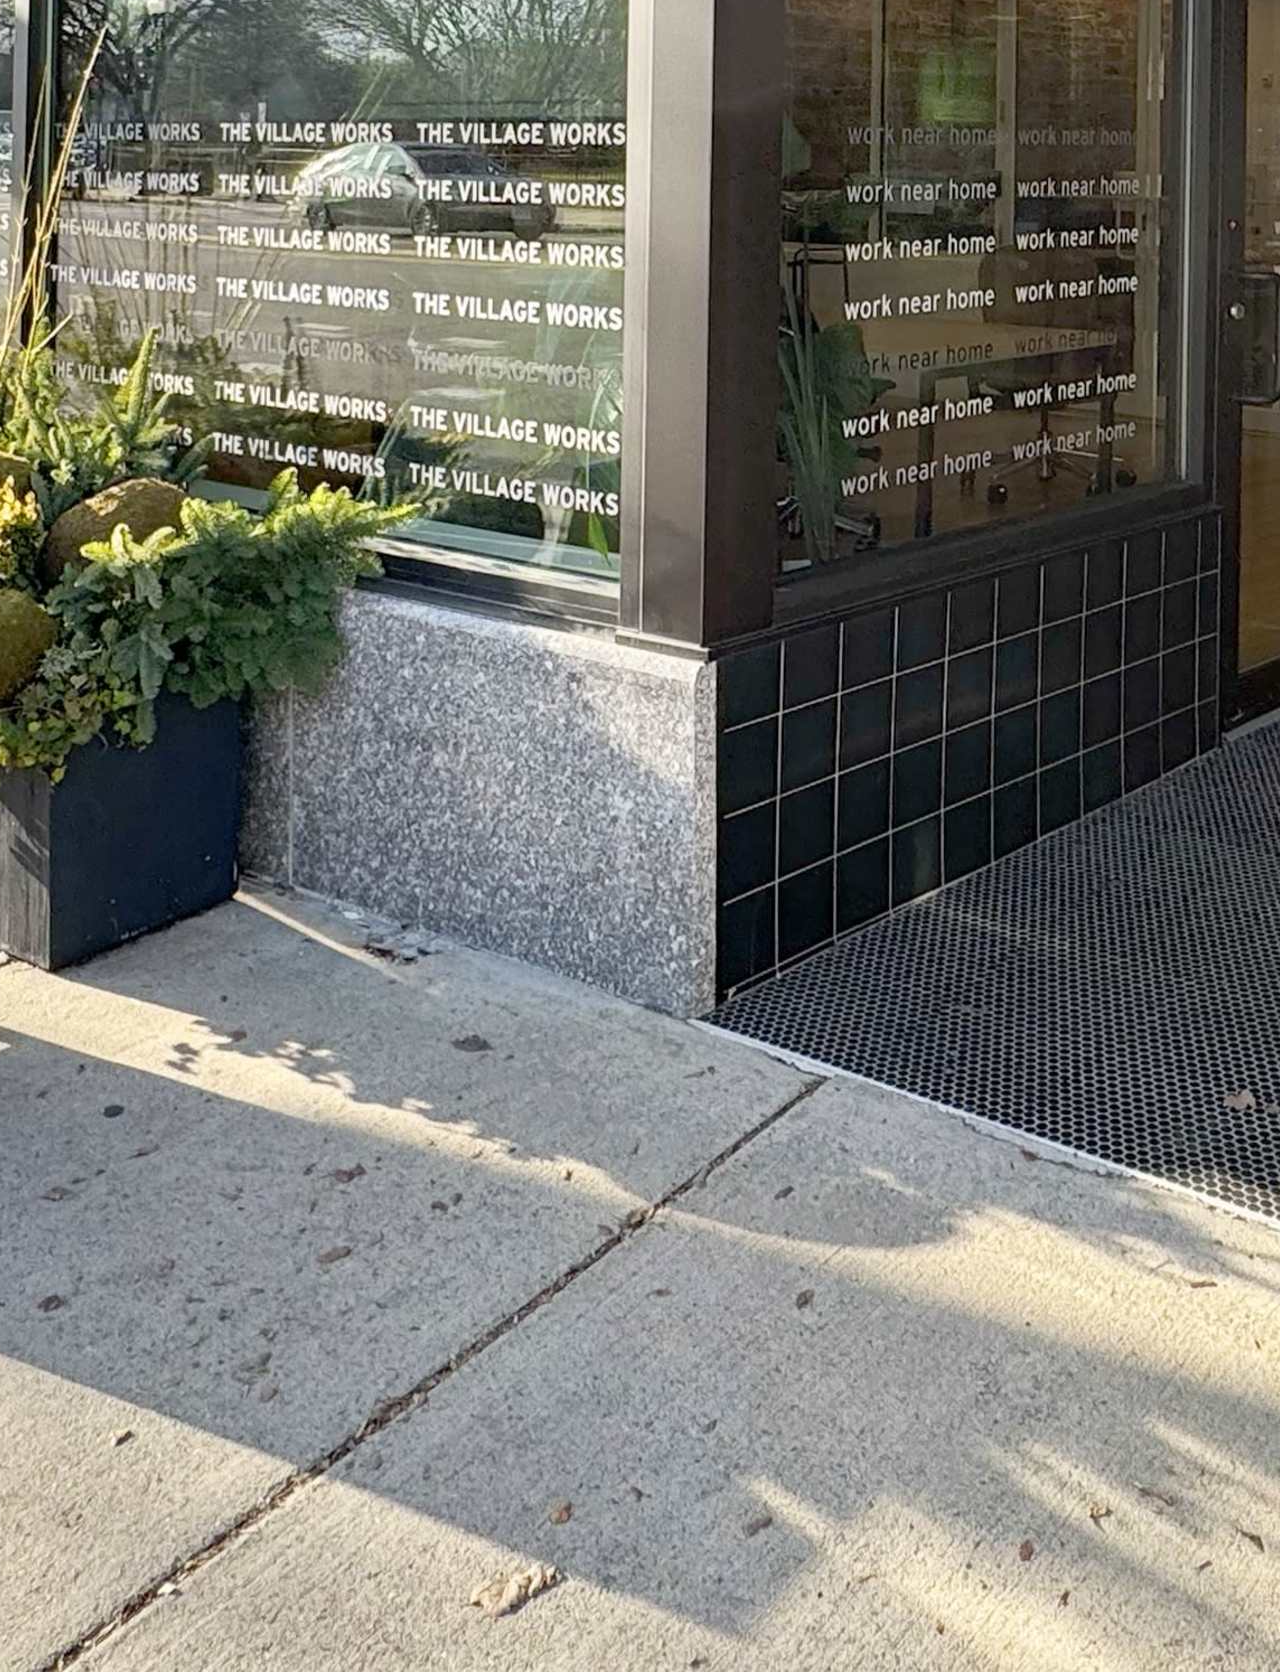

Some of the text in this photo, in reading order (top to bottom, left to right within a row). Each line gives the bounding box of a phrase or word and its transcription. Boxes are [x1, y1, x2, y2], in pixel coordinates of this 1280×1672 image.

[84, 123, 144, 141] VILLAGE
[148, 123, 201, 141] WORKS
[220, 122, 393, 143] THE VILLAGE WORKS
[417, 122, 626, 146] THE VILLAGE WORKS
[848, 122, 996, 145] work near home
[1019, 125, 1133, 145] work near hom
[83, 171, 143, 192] VILLAGE
[147, 172, 200, 192] WORKS
[219, 174, 392, 199] THE VILLAGE WORKS
[417, 180, 625, 207] THE VILLAGE WORKS
[847, 178, 997, 203] work near home
[1017, 175, 1140, 198] work near home
[54, 217, 198, 243] THE VILLAGE WORKS
[217, 226, 391, 255] THE VILLAGE WORKS
[1016, 225, 1139, 250] work near home
[414, 236, 624, 268] THE VILLAGE WORKS
[846, 233, 996, 262] work near home
[50, 265, 196, 293] THE VILLAGE WORKS
[1015, 273, 1138, 303] work near home
[216, 277, 390, 310] THE VILLAGE WORKS
[844, 288, 995, 320] work near home
[412, 292, 623, 330] THE VILLAGE WORKS
[250, 331, 321, 357] VILLAGE
[899, 349, 938, 370] near
[947, 343, 994, 364] home
[1014, 332, 1052, 354] work
[1059, 331, 1093, 348] near
[78, 363, 129, 385] VILLAG
[411, 348, 449, 374] THE
[452, 353, 539, 383] VILLAGE
[215, 381, 386, 423] THE VILLAGE WORKS
[1013, 373, 1137, 408] work near home
[410, 405, 620, 455] THE VILLAGE WORKS
[842, 396, 993, 438] work near home
[212, 432, 244, 455] THE
[248, 437, 318, 466] VILLAGE
[323, 449, 385, 478] WORKS
[1012, 421, 1136, 461] work near home
[841, 450, 992, 497] work near home
[409, 463, 619, 516] THE VILLAGE WORKS
